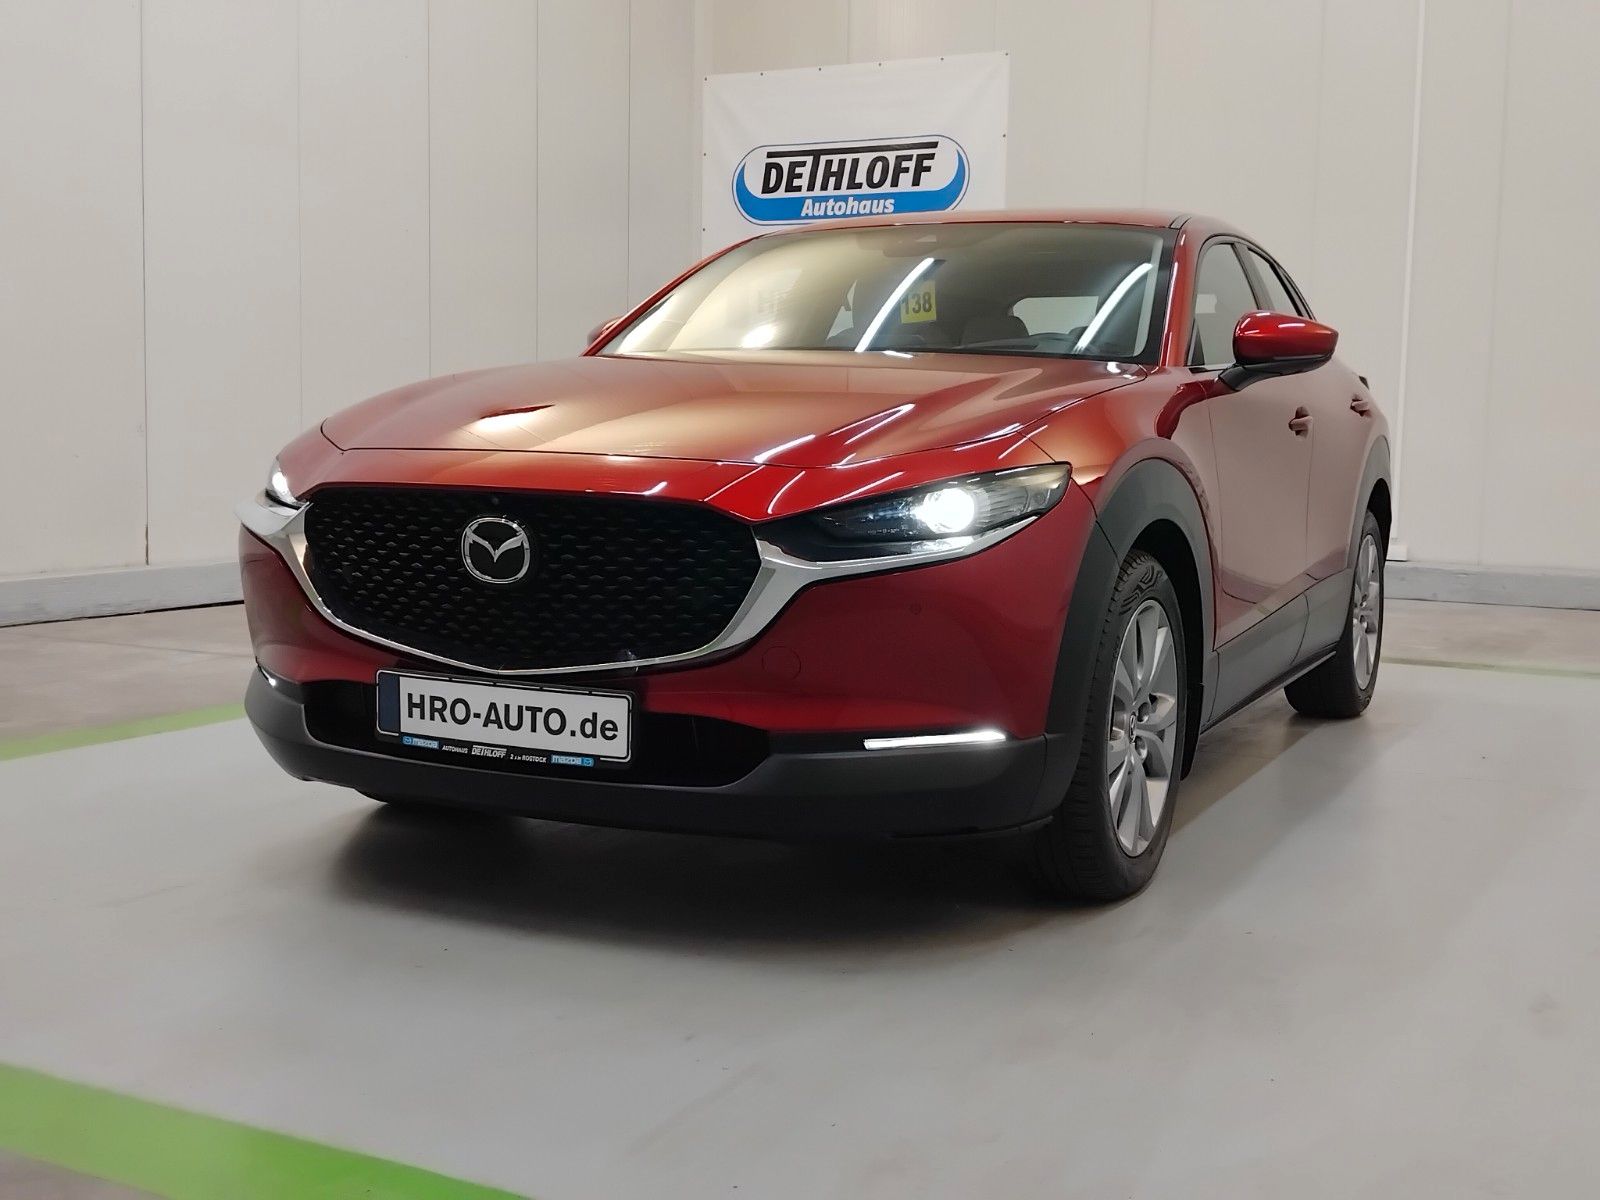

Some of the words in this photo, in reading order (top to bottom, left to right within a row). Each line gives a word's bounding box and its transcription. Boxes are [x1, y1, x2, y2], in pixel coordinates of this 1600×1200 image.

[761, 141, 939, 195] DETHLOFF
[800, 196, 895, 217] Autohaus
[901, 291, 932, 315] 138
[407, 692, 619, 741] HRO-AUTO.de
[471, 745, 507, 759] DETHLOFF
[522, 754, 547, 763] ROSTOCK
[551, 754, 581, 765] mazda
